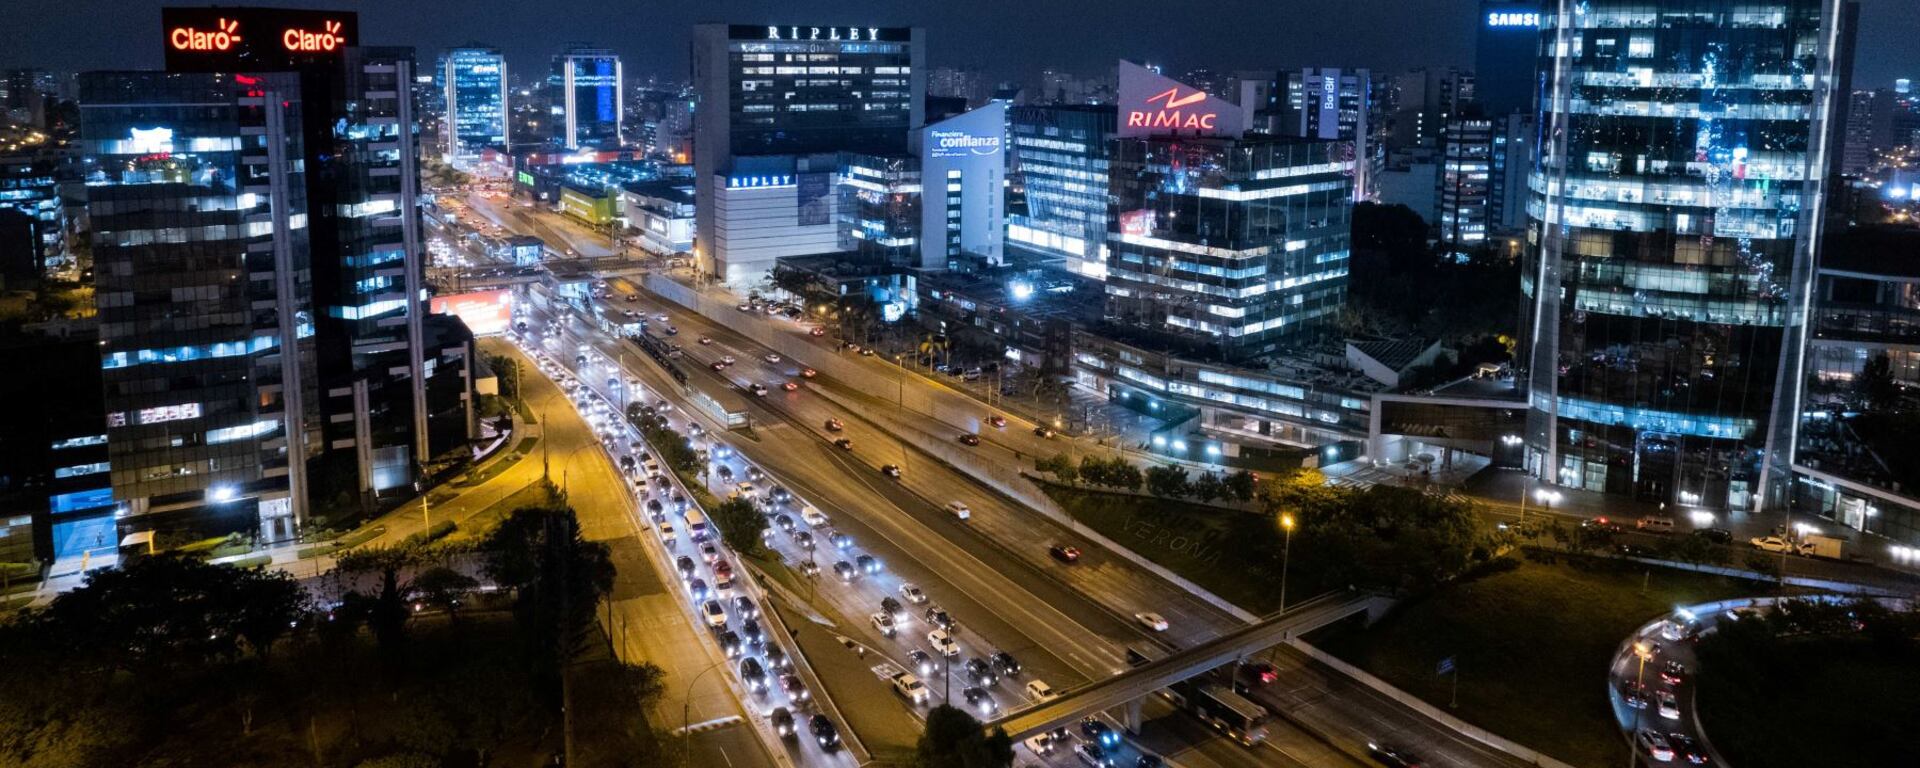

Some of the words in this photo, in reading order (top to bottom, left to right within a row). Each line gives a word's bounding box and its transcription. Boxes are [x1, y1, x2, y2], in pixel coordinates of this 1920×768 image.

[171, 26, 231, 50] Claro
[283, 28, 336, 51] Claro
[767, 26, 879, 41] RIPLEY
[1324, 76, 1335, 110] BanBif
[1127, 110, 1217, 130] RIMAC
[940, 135, 999, 148] confianza
[731, 175, 791, 188] RIPLEY
